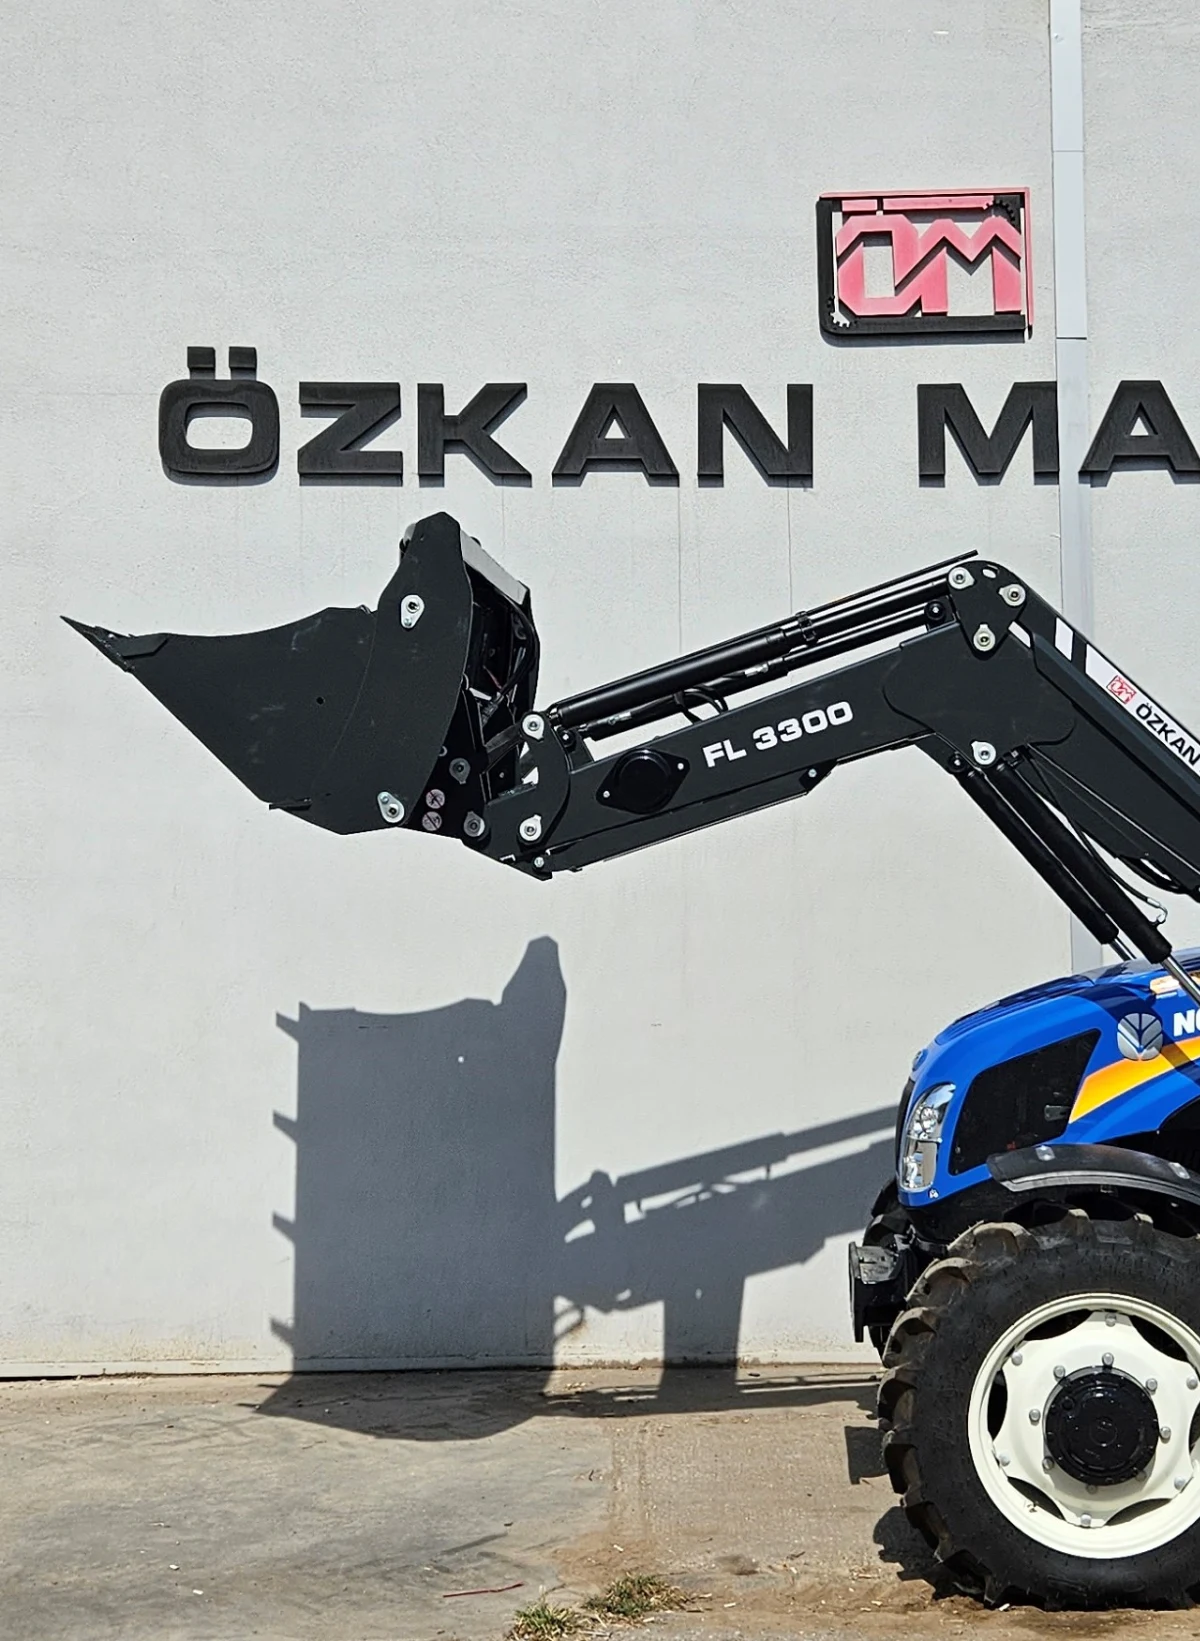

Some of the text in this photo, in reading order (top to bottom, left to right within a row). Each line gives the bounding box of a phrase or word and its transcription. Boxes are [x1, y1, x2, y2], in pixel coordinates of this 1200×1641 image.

[158, 346, 813, 487] ÖZKAN
[702, 701, 854, 768] FL 3300
